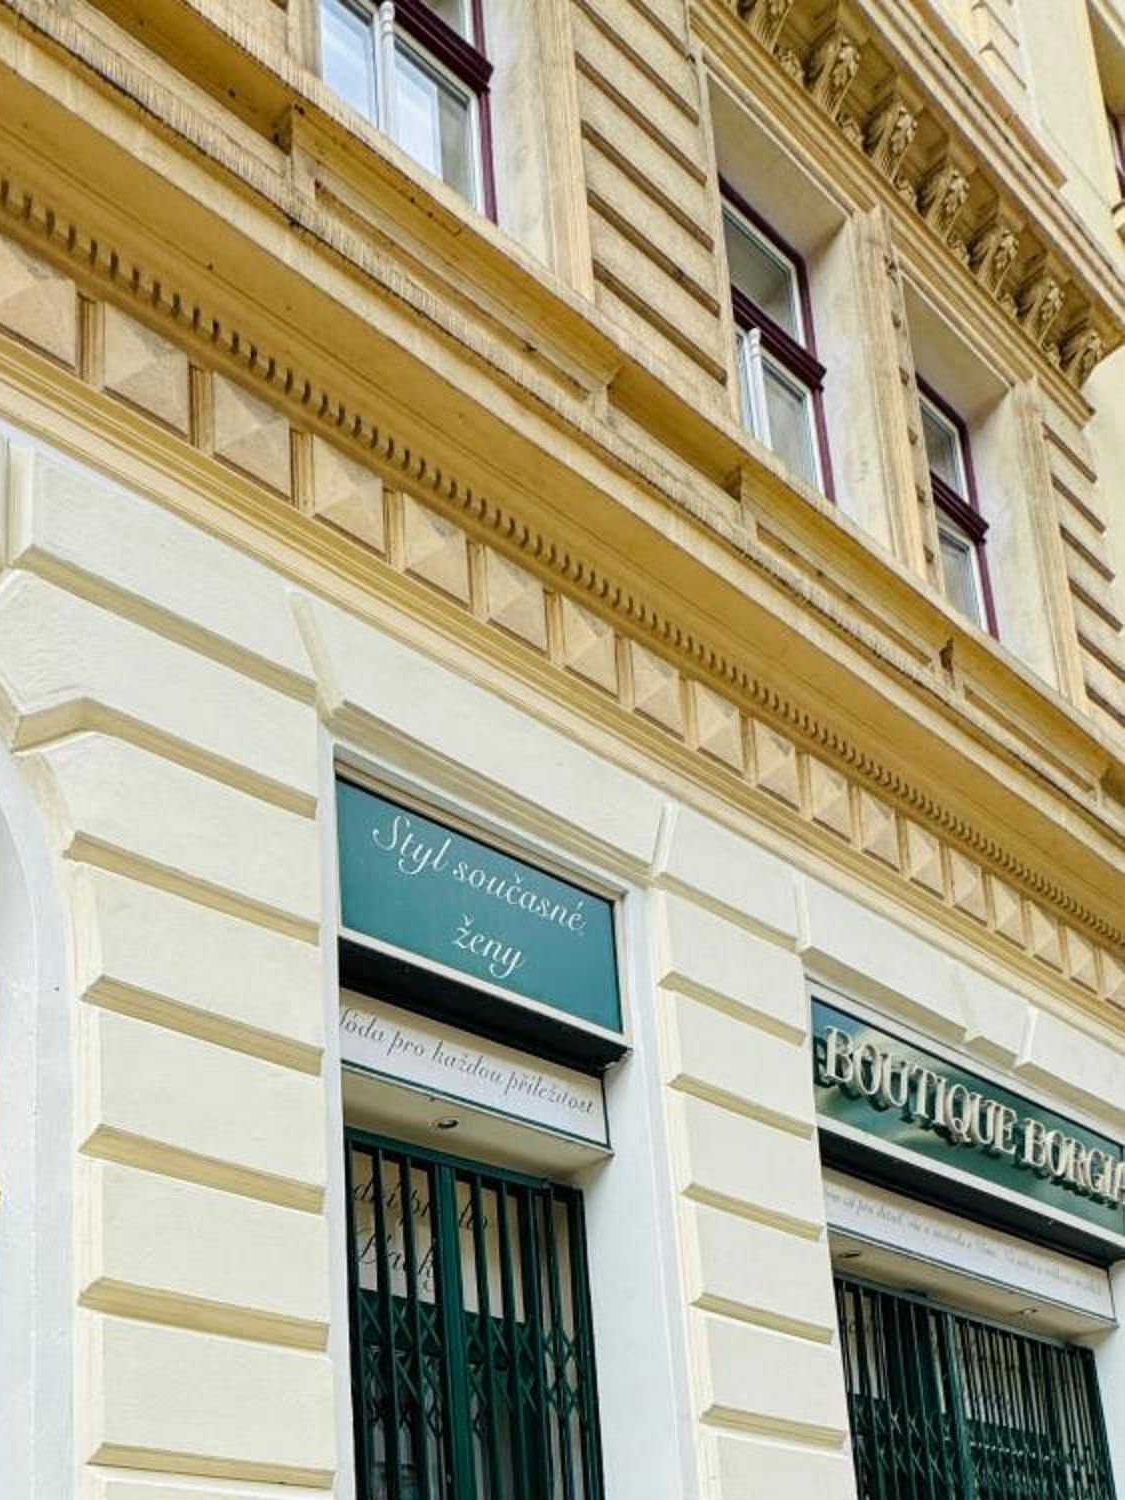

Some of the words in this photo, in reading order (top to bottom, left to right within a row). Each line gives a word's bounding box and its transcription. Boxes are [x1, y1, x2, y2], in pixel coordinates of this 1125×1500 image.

[372, 815, 453, 875] Styl
[451, 861, 588, 932] současné
[451, 912, 525, 979] ženy
[386, 1030, 425, 1057] pro
[432, 1040, 502, 1083] každou
[503, 1071, 594, 1115] příležitost
[824, 1025, 1018, 1155] BOUTIQUE
